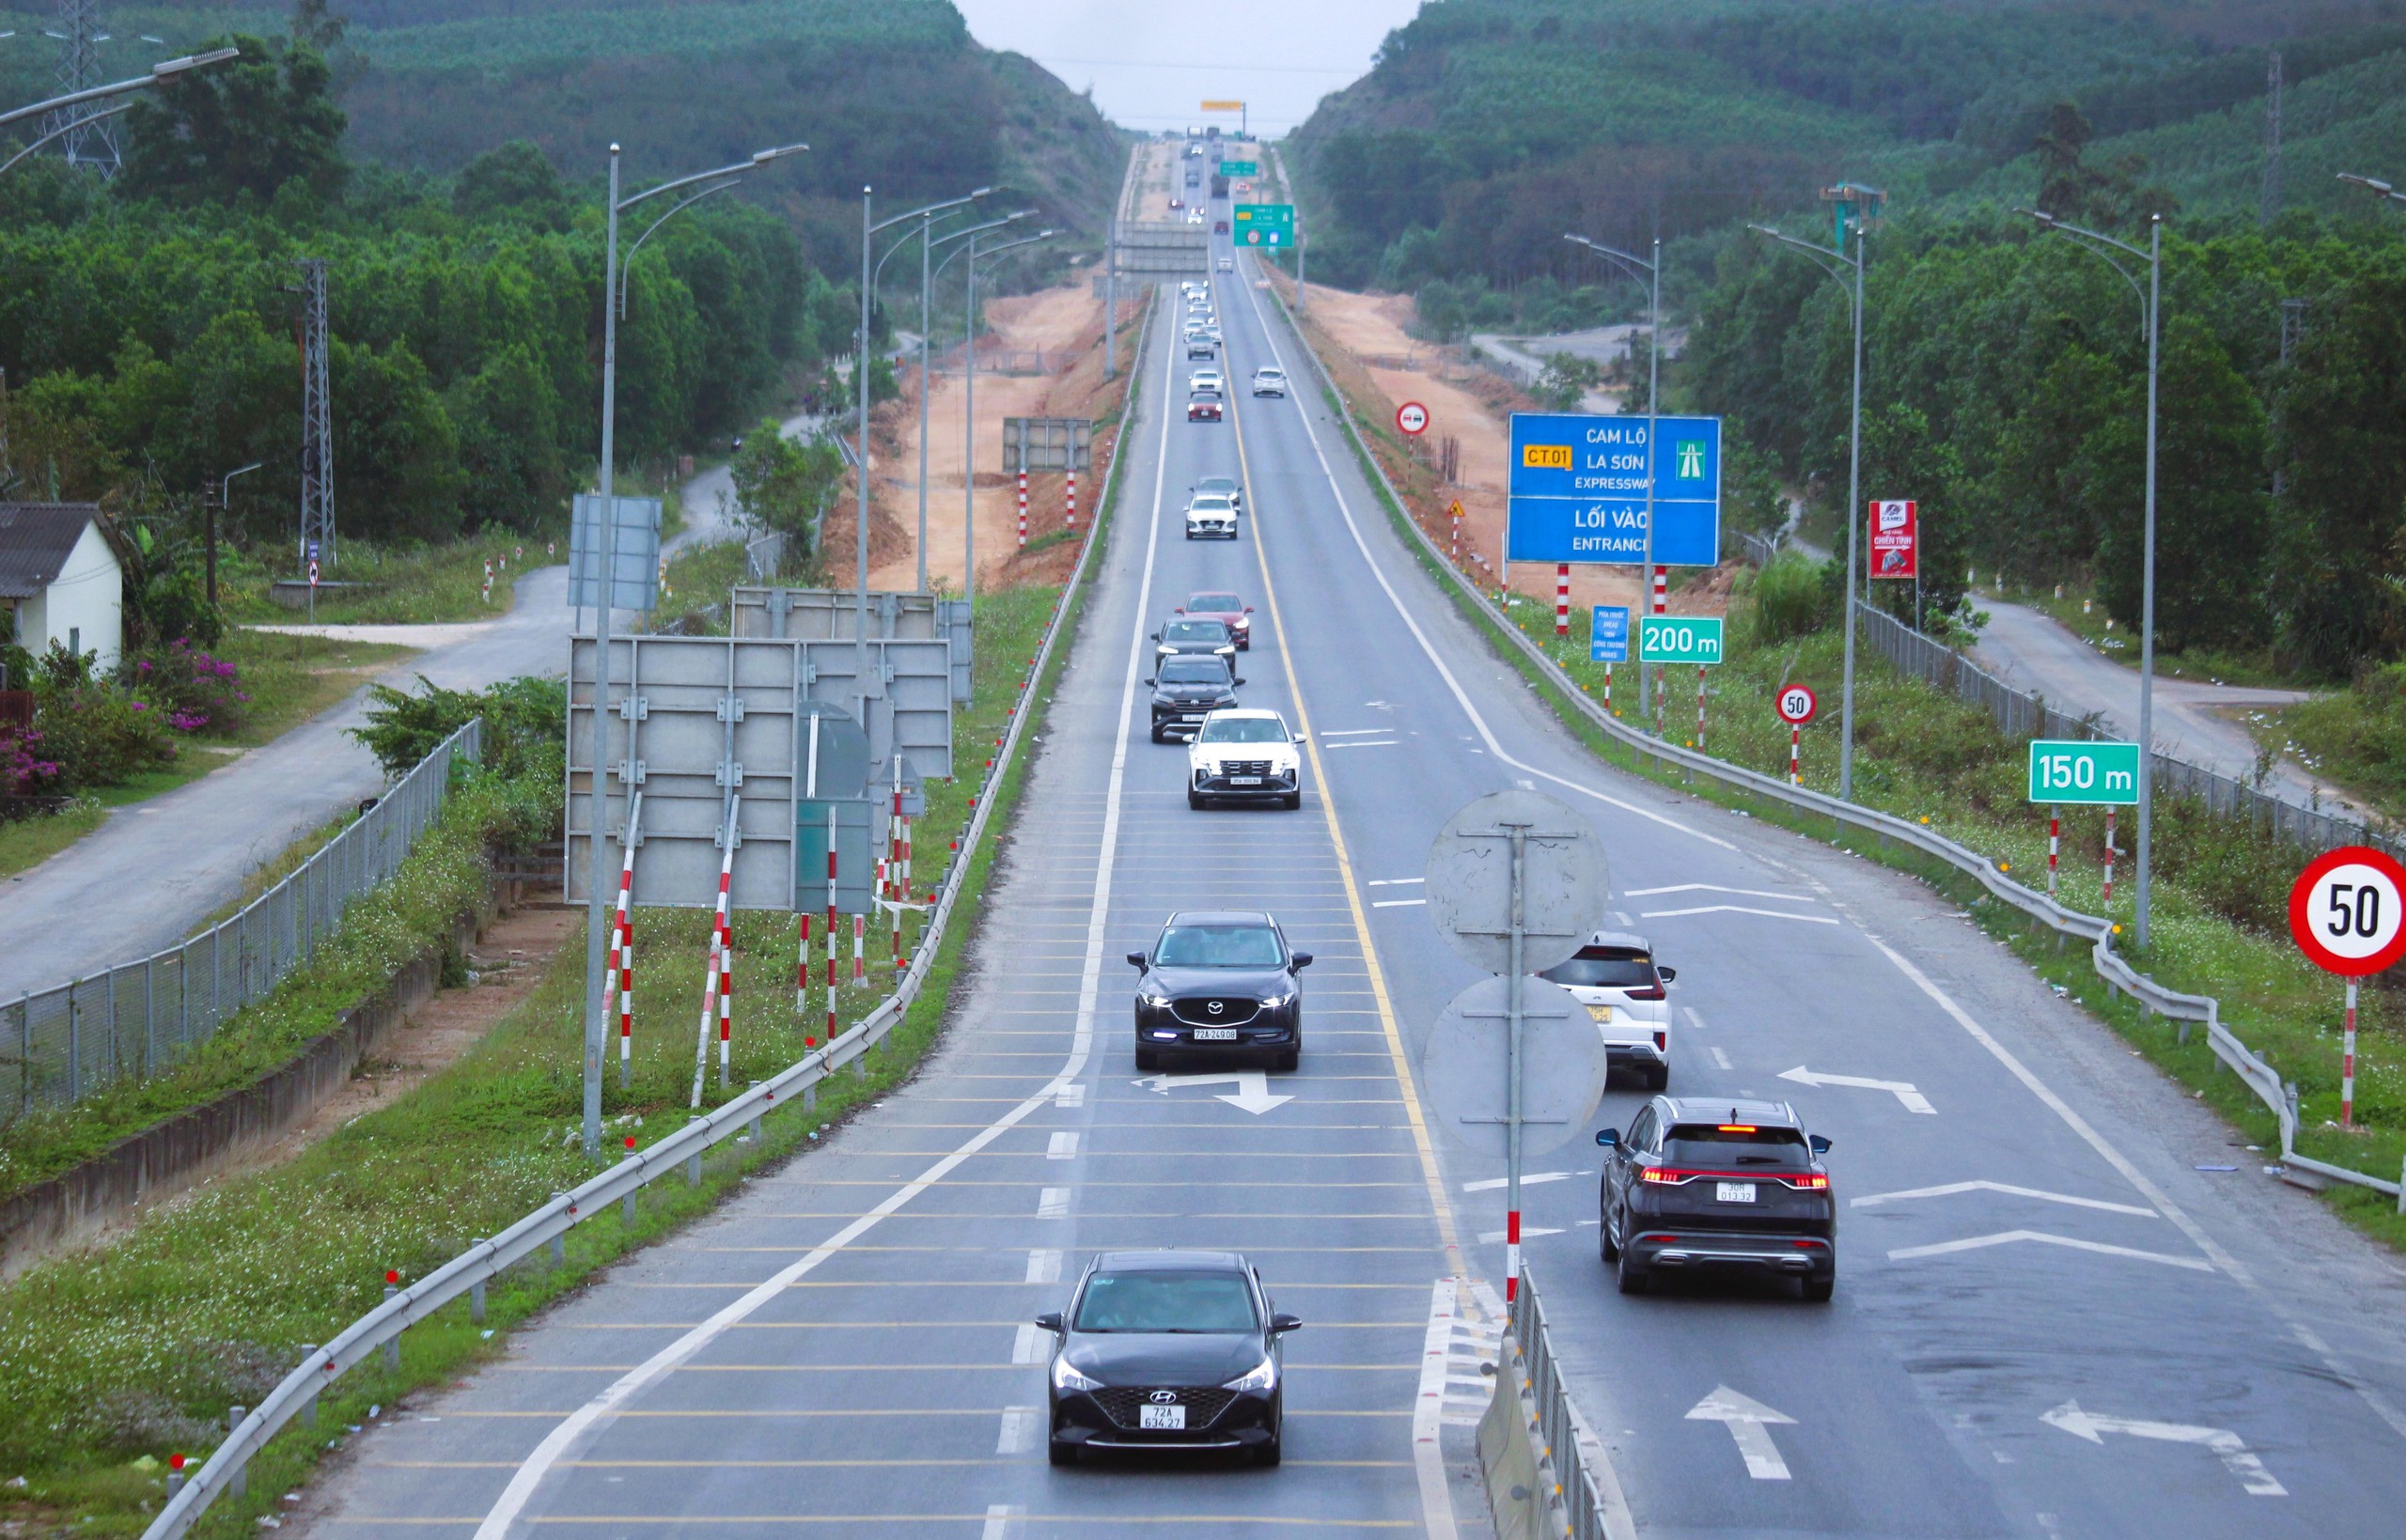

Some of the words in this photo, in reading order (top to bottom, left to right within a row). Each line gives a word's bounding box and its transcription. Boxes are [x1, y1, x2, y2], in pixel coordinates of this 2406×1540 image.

[1586, 428, 1621, 444] CAM
[1625, 427, 1647, 448] LỘ
[1528, 449, 1567, 464] CT.01
[1586, 455, 1607, 469] LA
[1610, 455, 1644, 470] SƠN
[1574, 476, 1656, 490] EXPRESSWA
[1574, 505, 1605, 528] LỐI
[1645, 628, 1693, 652] 200
[1697, 639, 1717, 652] m
[1788, 697, 1804, 714] 50
[2039, 755, 2094, 788] 150
[2105, 771, 2132, 789] m
[2328, 884, 2379, 937] 50
[1722, 1192, 1751, 1201] 013.32
[1153, 1408, 1172, 1417] 72A
[1145, 1419, 1180, 1428] 634.27
